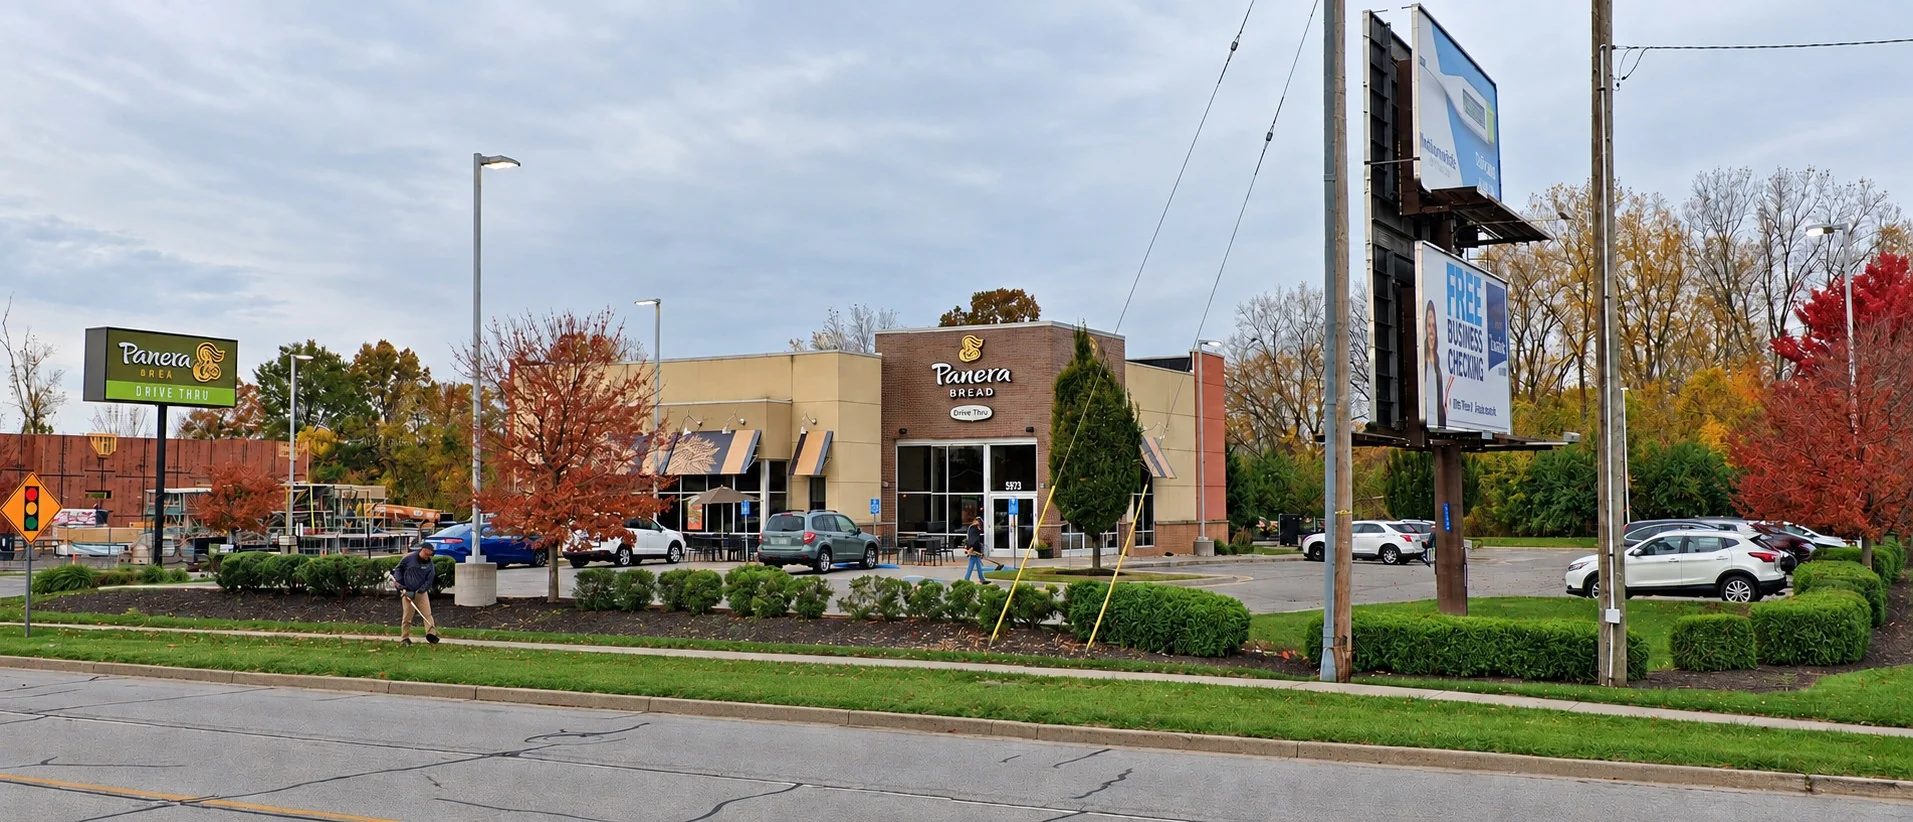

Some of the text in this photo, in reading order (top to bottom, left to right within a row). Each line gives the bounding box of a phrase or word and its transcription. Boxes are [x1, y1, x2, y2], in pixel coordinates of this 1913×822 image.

[1446, 262, 1482, 327] FREE
[1447, 318, 1483, 354] BUSINESS
[118, 341, 191, 369] Panera
[1447, 348, 1484, 382] CHECKING
[931, 362, 1012, 386] Panera
[136, 385, 209, 401] DRIVE THRU
[949, 387, 994, 398] BREAD
[953, 408, 989, 417] Drive Thru
